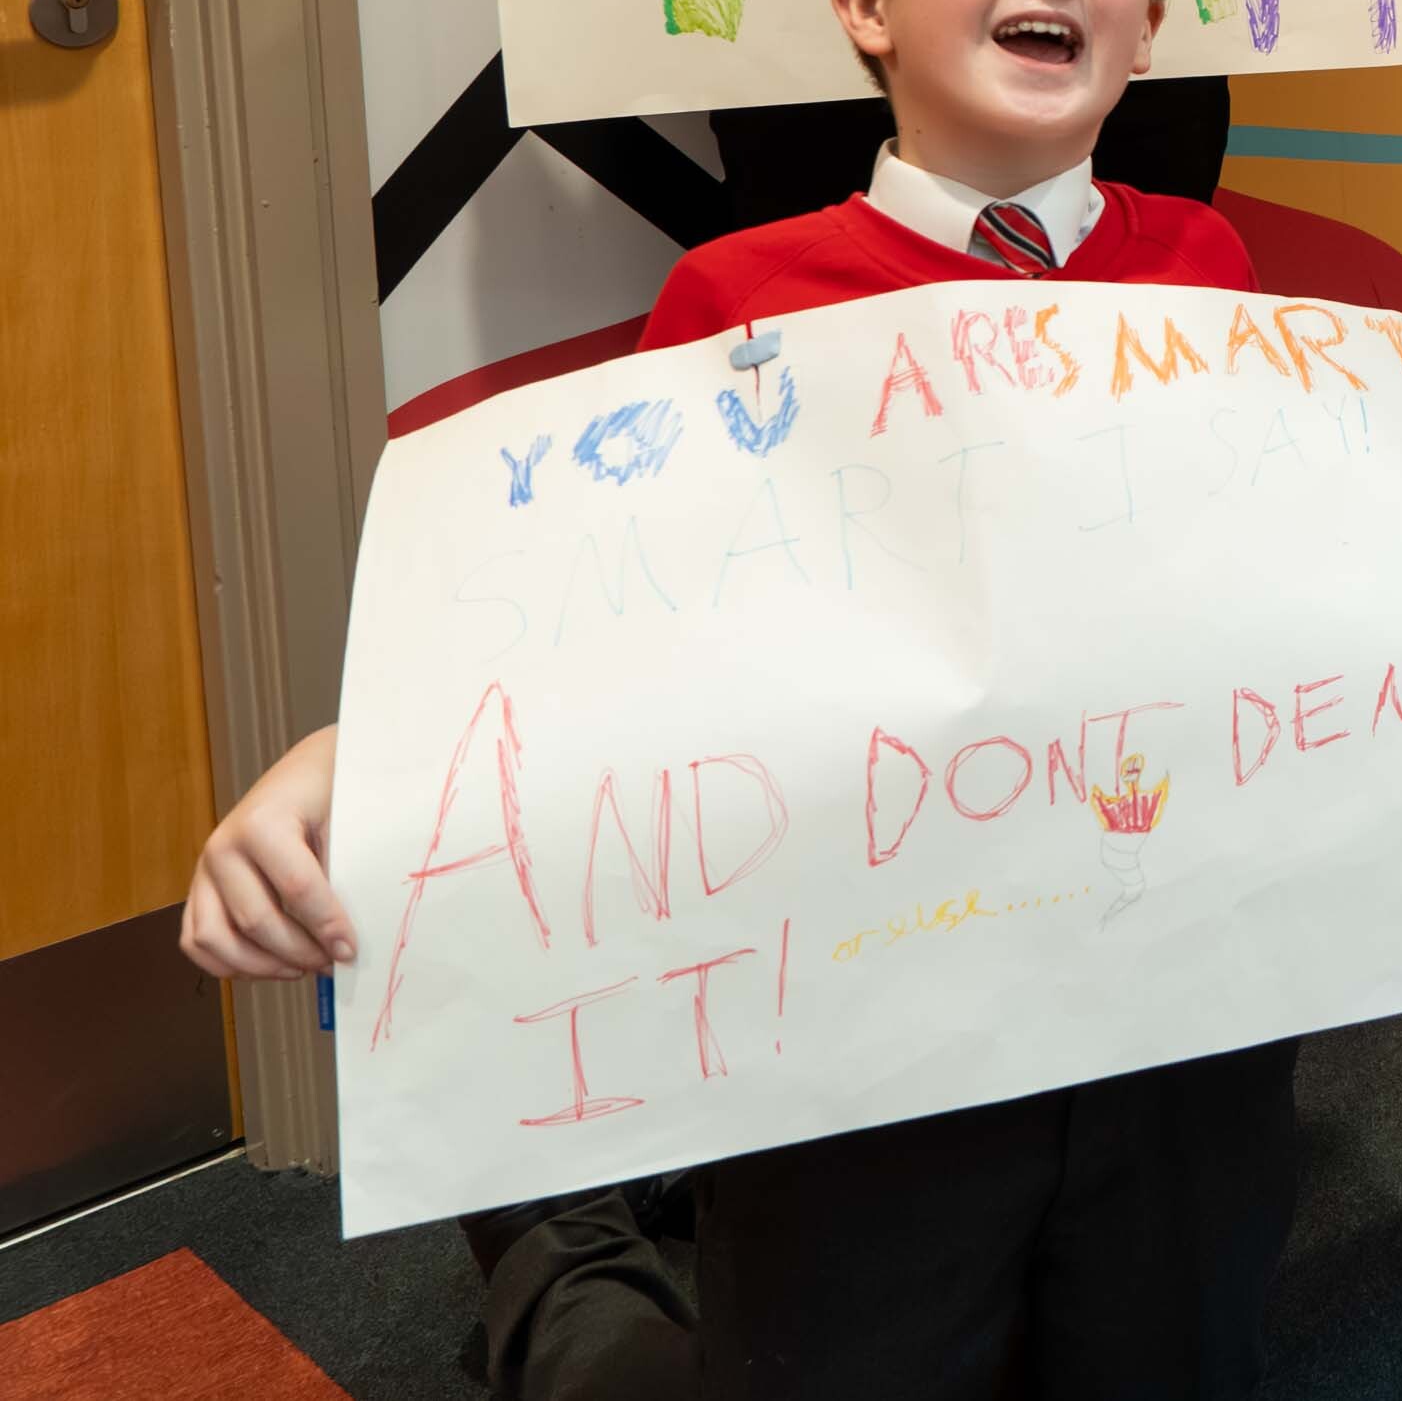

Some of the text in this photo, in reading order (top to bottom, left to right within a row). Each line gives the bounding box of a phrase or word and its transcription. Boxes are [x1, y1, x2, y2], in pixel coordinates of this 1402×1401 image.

[500, 366, 801, 509] YOU
[870, 304, 1054, 439] ARE
[453, 441, 1004, 664] SMART
[370, 681, 789, 1052] AND
[515, 919, 792, 1127] IT!
